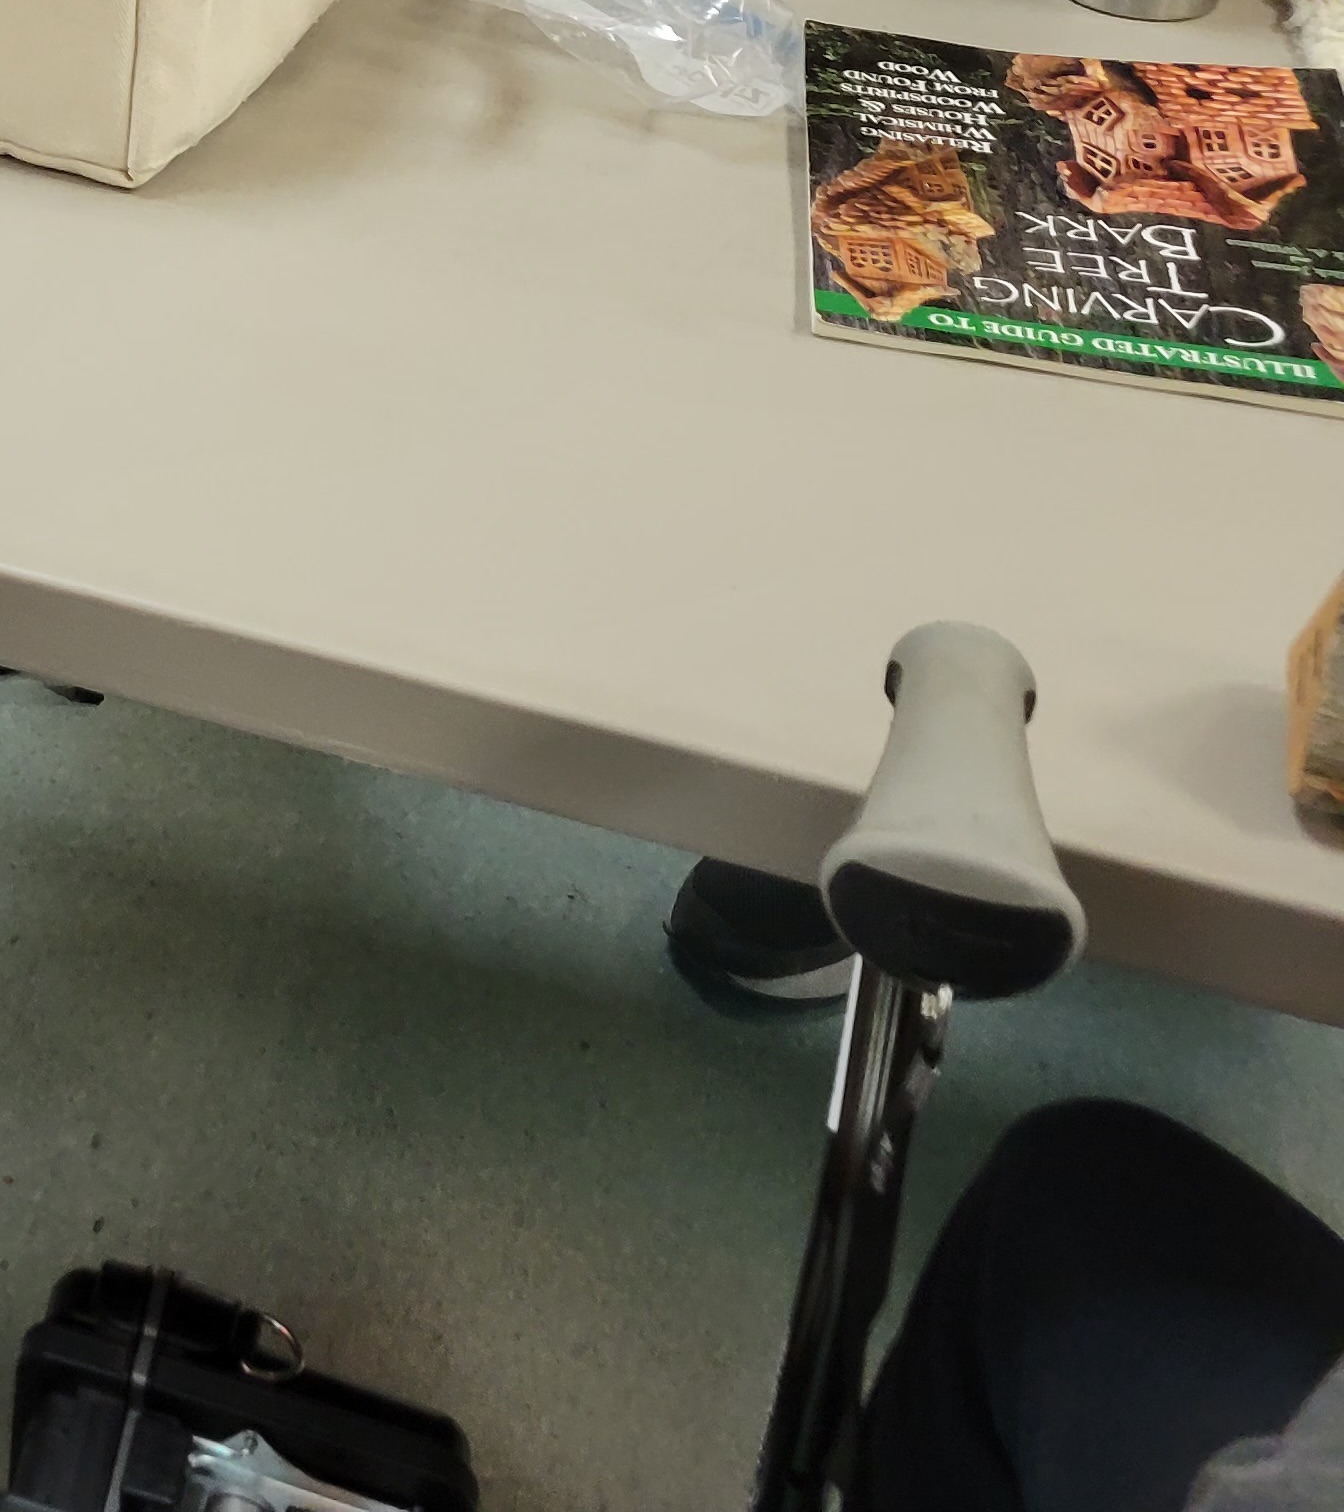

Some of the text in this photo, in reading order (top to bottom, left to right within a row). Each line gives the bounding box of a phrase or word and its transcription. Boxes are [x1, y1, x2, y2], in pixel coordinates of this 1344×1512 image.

[842, 69, 998, 98] FROM FOUND
[877, 61, 960, 82] WOOD
[841, 83, 1006, 114] WOODSPIRITS
[856, 98, 989, 126] HOUSES &
[853, 112, 996, 140] WHIMSICAL
[861, 127, 992, 153] RELEASING
[1014, 210, 1202, 262] BARK
[1021, 246, 1209, 299] TREE
[971, 275, 1287, 348] CARVING
[927, 312, 1318, 379] ILLUSTRATED GUIDE TO
